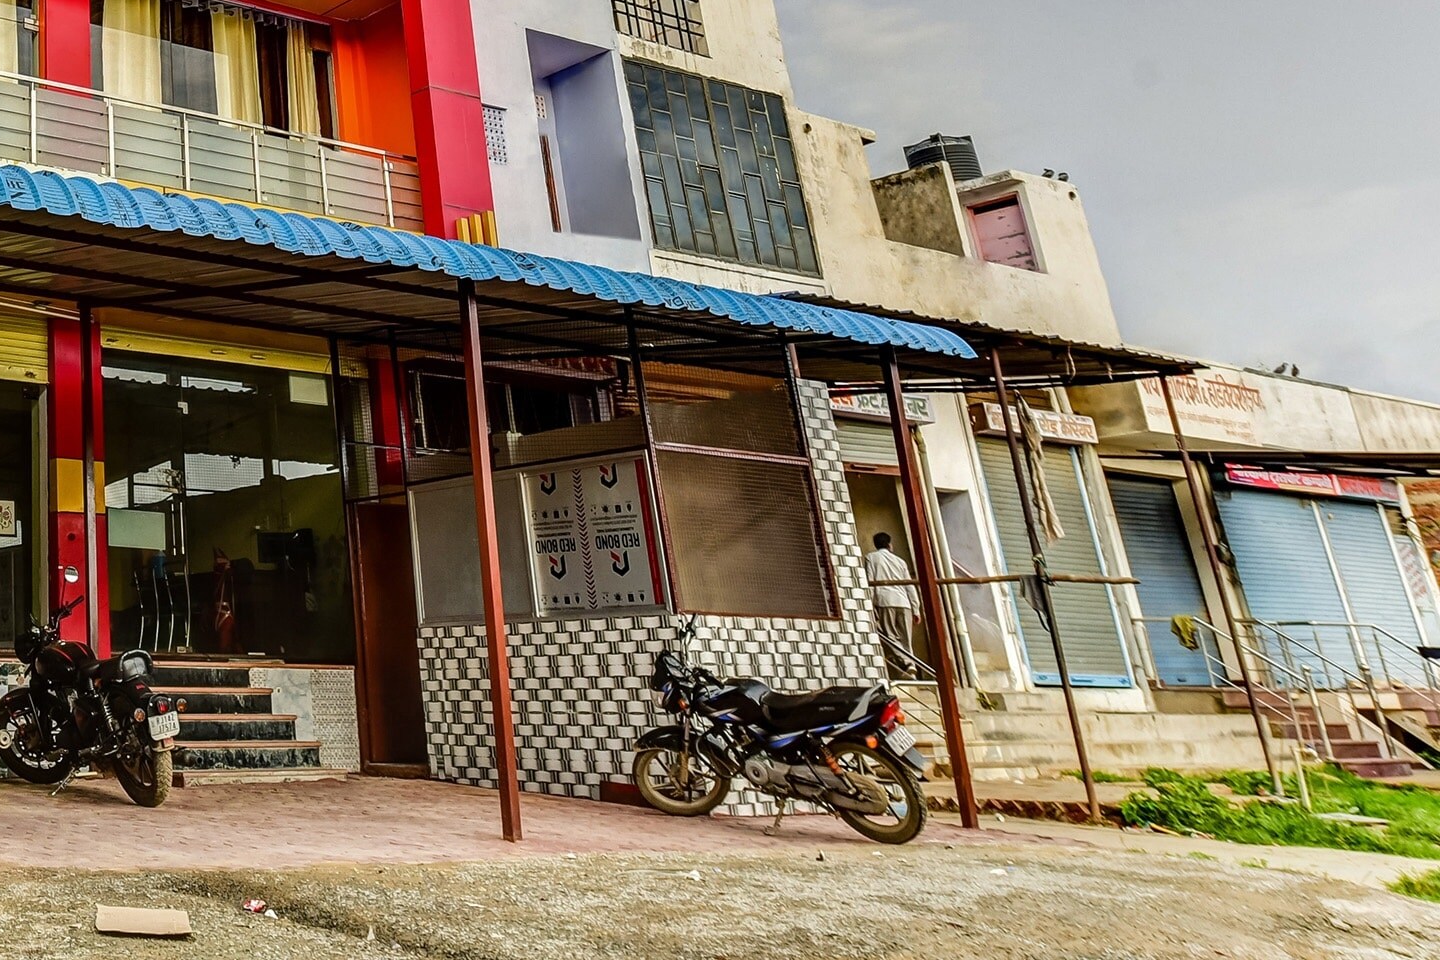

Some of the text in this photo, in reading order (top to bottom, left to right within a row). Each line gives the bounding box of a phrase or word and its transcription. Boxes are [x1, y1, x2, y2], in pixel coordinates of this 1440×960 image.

[536, 537, 576, 554] RED BOND
[595, 533, 640, 550] RED BOND
